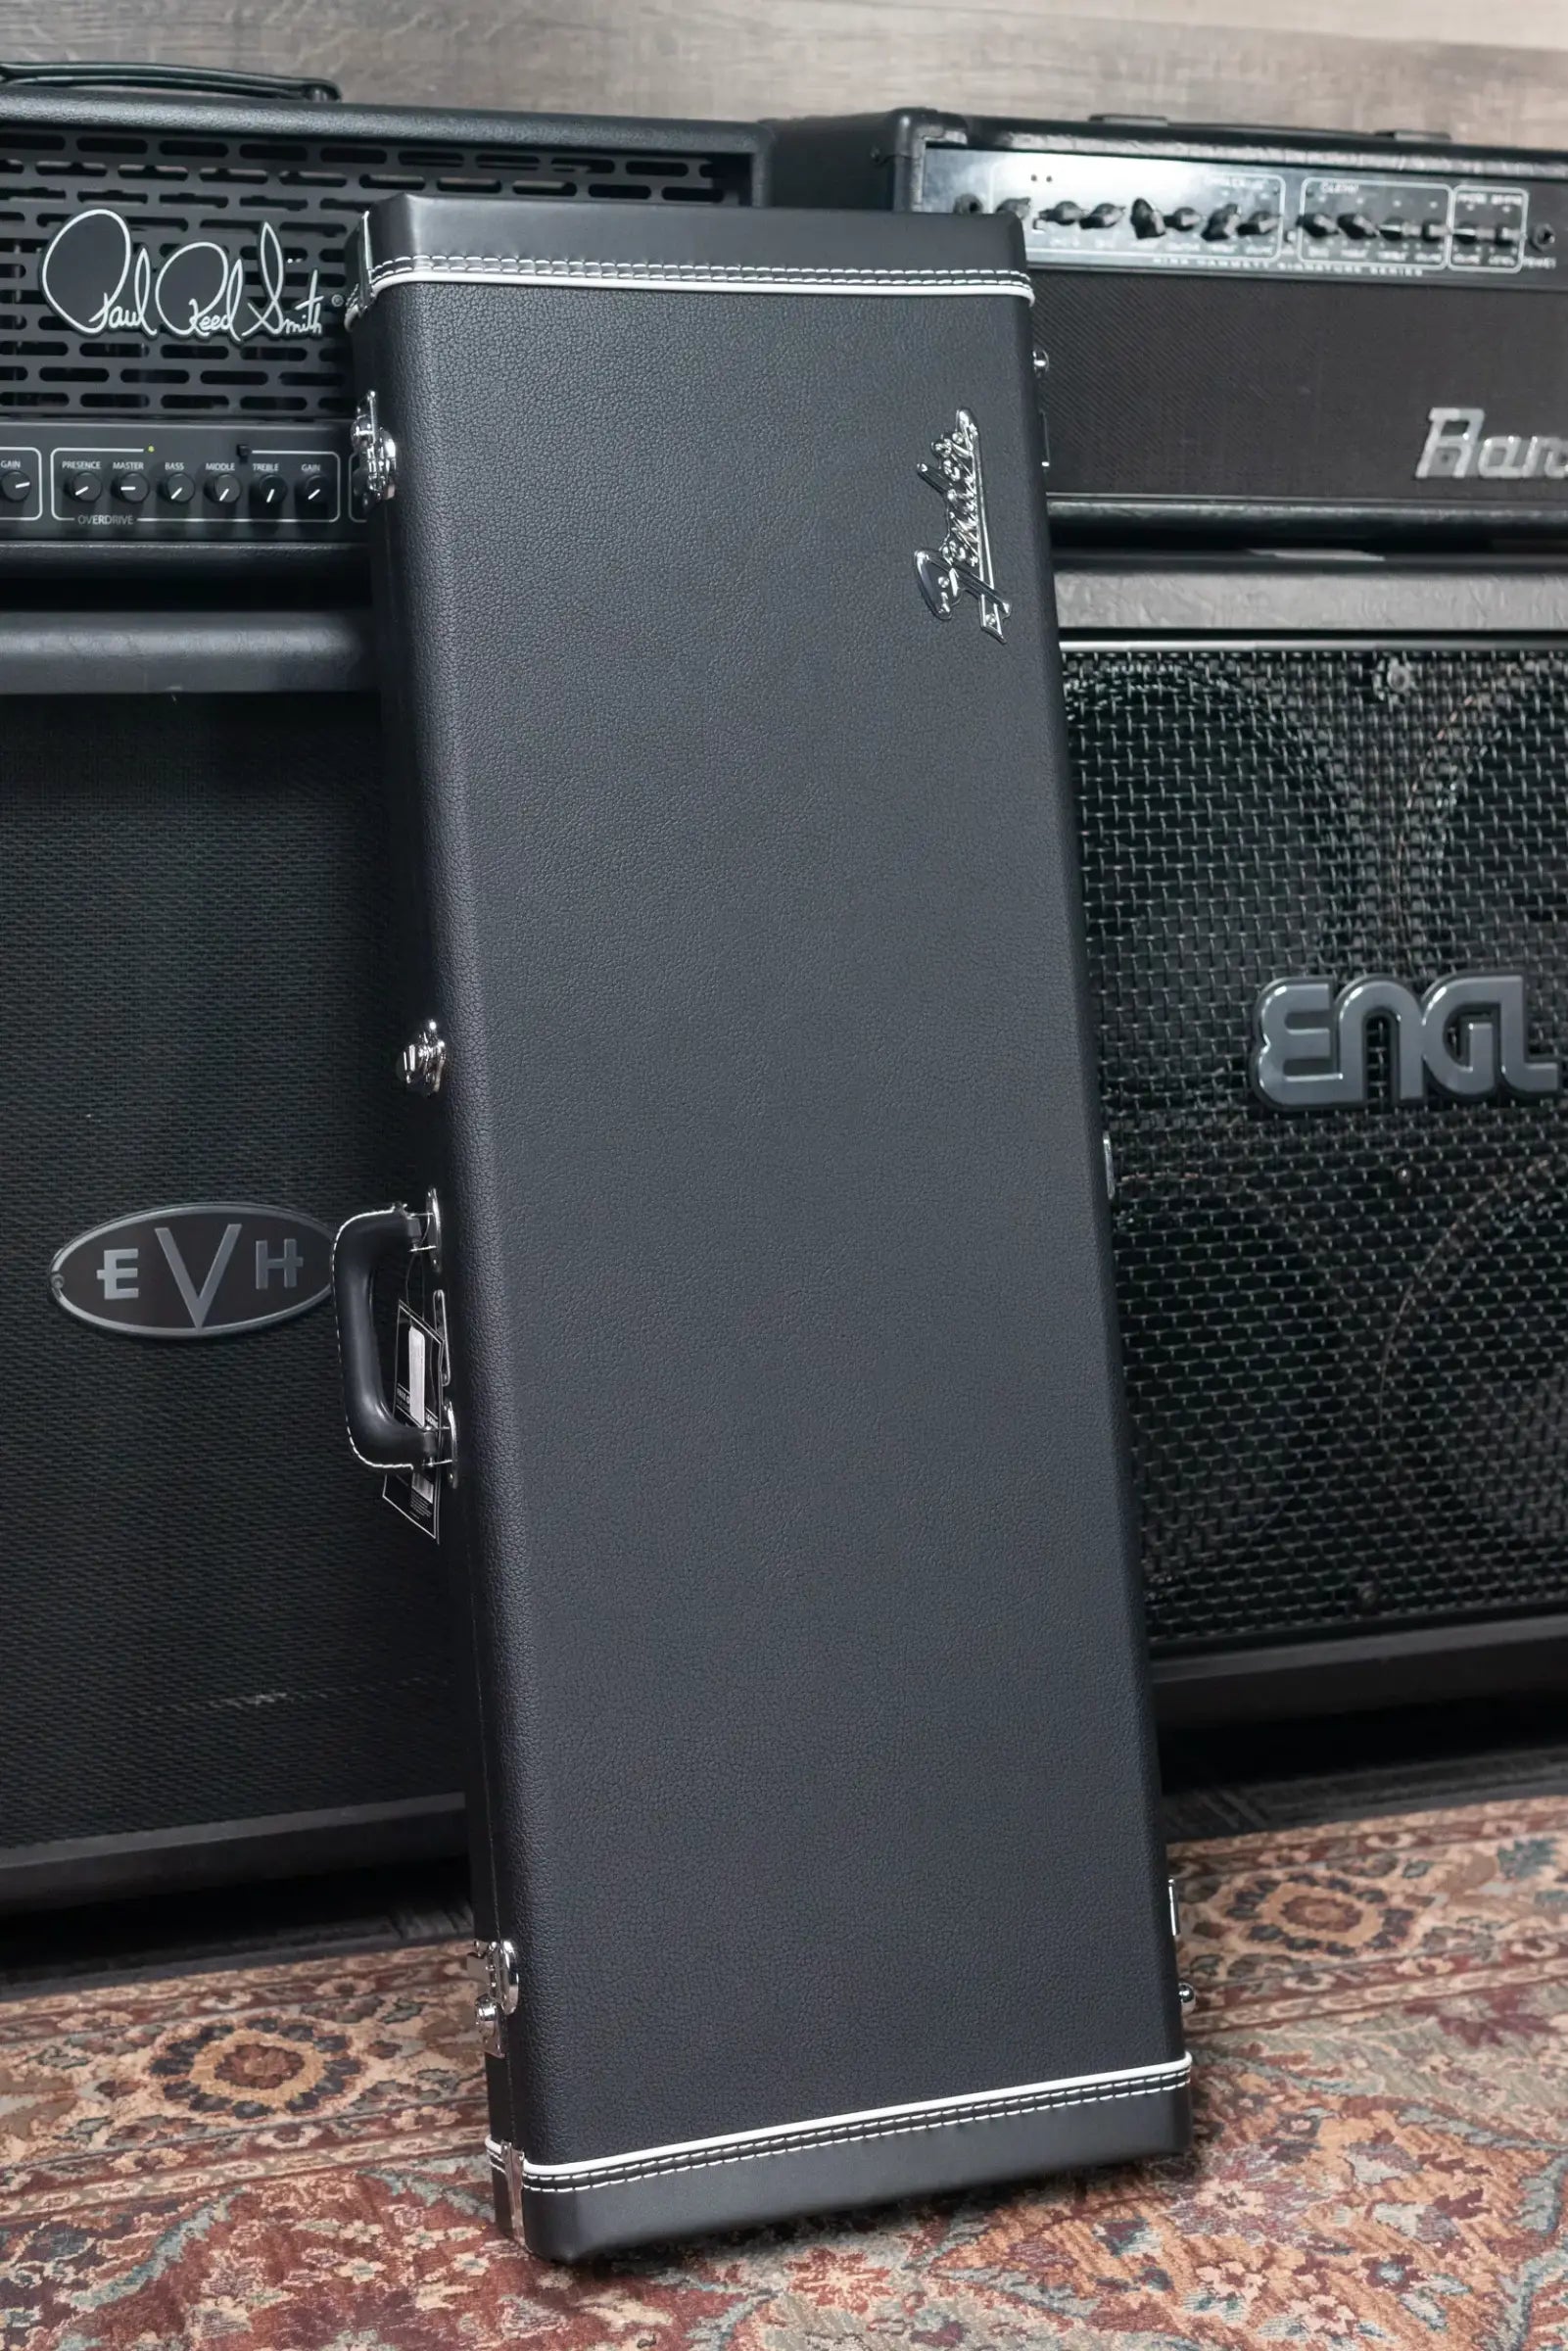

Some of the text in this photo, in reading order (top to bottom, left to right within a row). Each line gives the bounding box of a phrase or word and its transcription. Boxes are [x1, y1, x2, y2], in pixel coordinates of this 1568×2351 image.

[42, 209, 323, 342] Paul Reed Smith
[1415, 407, 1568, 479] Ran
[0, 459, 22, 469] GAIN
[62, 460, 102, 470] PRESENCE
[112, 461, 145, 470] MASTER
[165, 462, 185, 471] BASS
[205, 462, 236, 471] MIDDLE
[252, 463, 279, 472] TREBLE
[77, 514, 134, 525] OVERDRIVE
[1255, 974, 1560, 1109] ENGL
[96, 1223, 305, 1329] EVH
